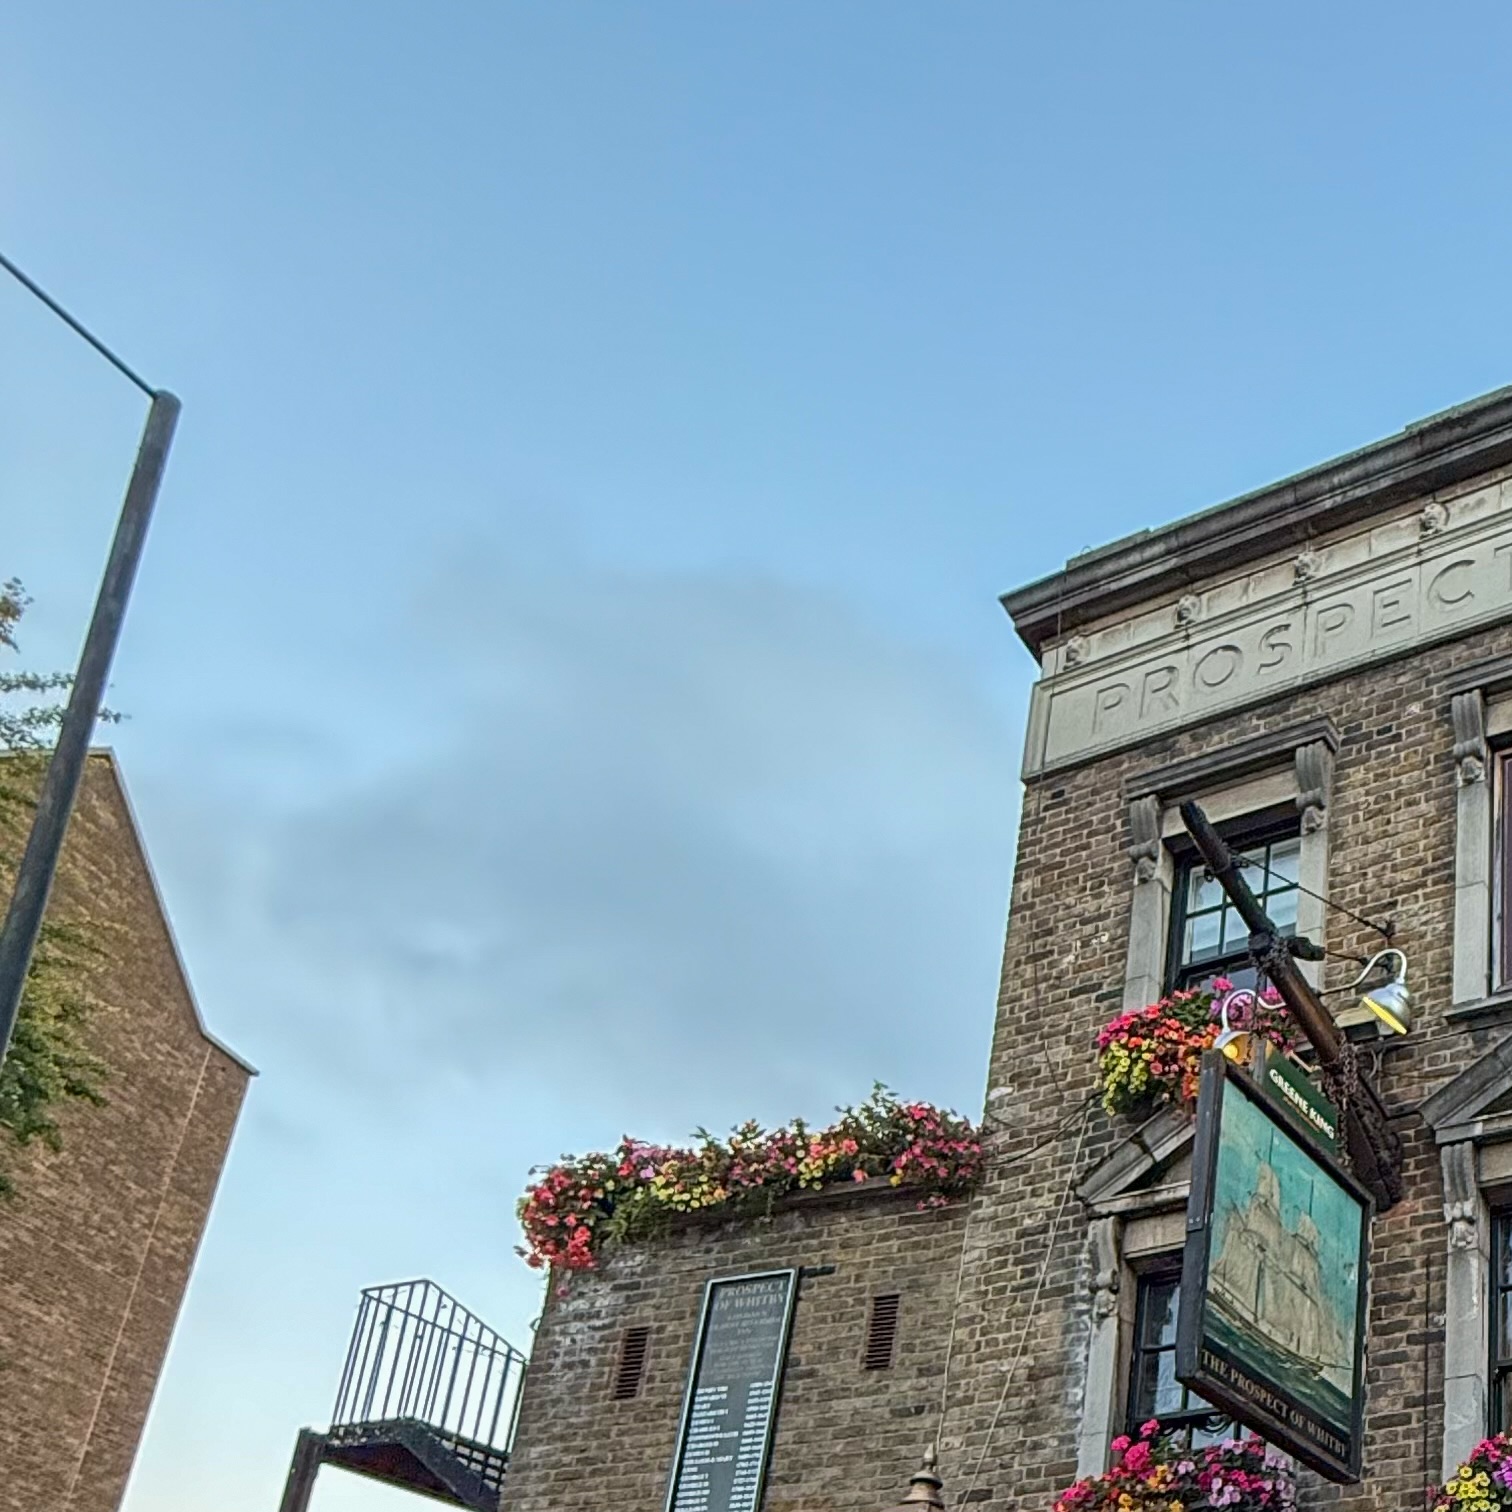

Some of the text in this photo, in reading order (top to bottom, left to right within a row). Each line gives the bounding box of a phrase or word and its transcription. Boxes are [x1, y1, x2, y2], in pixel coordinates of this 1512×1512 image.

[1269, 1069, 1308, 1115] GREENE
[1309, 1107, 1335, 1139] KING
[1201, 1349, 1228, 1375] THE
[1230, 1367, 1289, 1418] PROSPECT
[1290, 1410, 1305, 1428] OF
